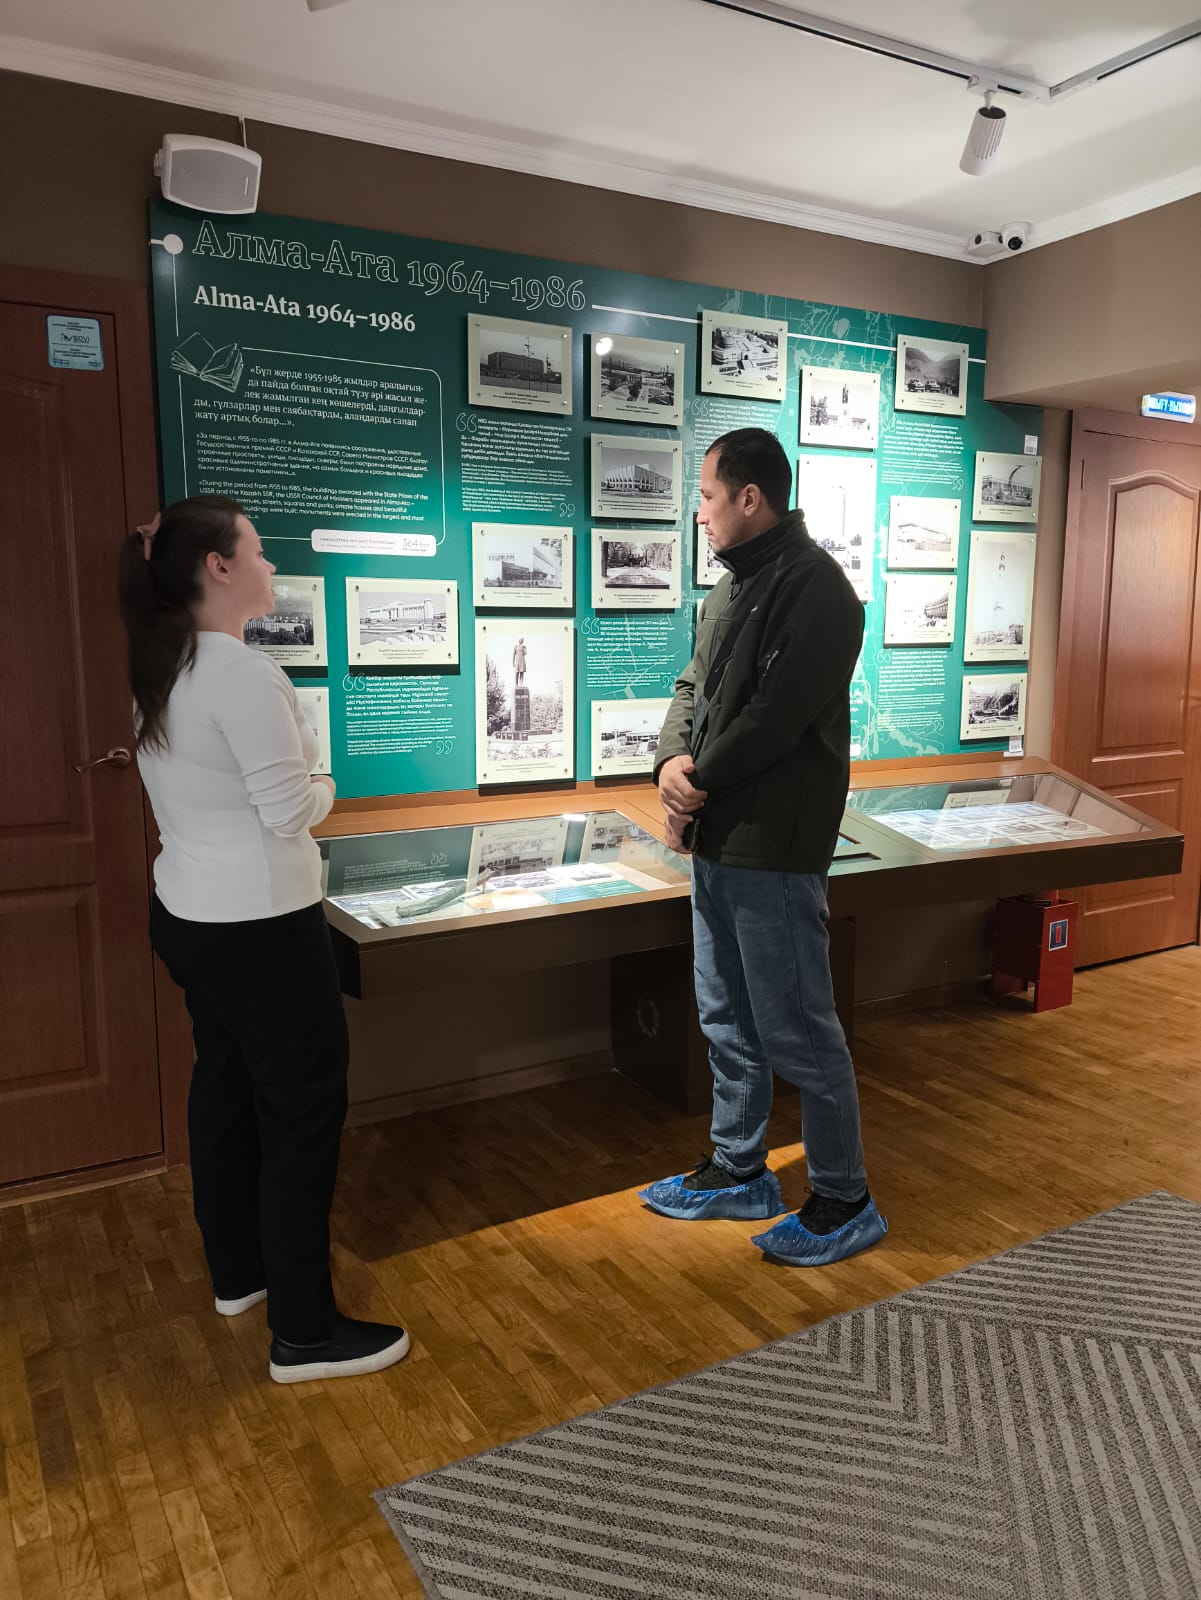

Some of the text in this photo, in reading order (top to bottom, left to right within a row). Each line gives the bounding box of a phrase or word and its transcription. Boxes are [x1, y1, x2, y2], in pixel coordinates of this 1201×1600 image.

[192, 219, 586, 312] Алма-Ата 1964–1986
[193, 285, 416, 333] Alma-Ata 1964–1986
[304, 373, 342, 385] 1955-1985
